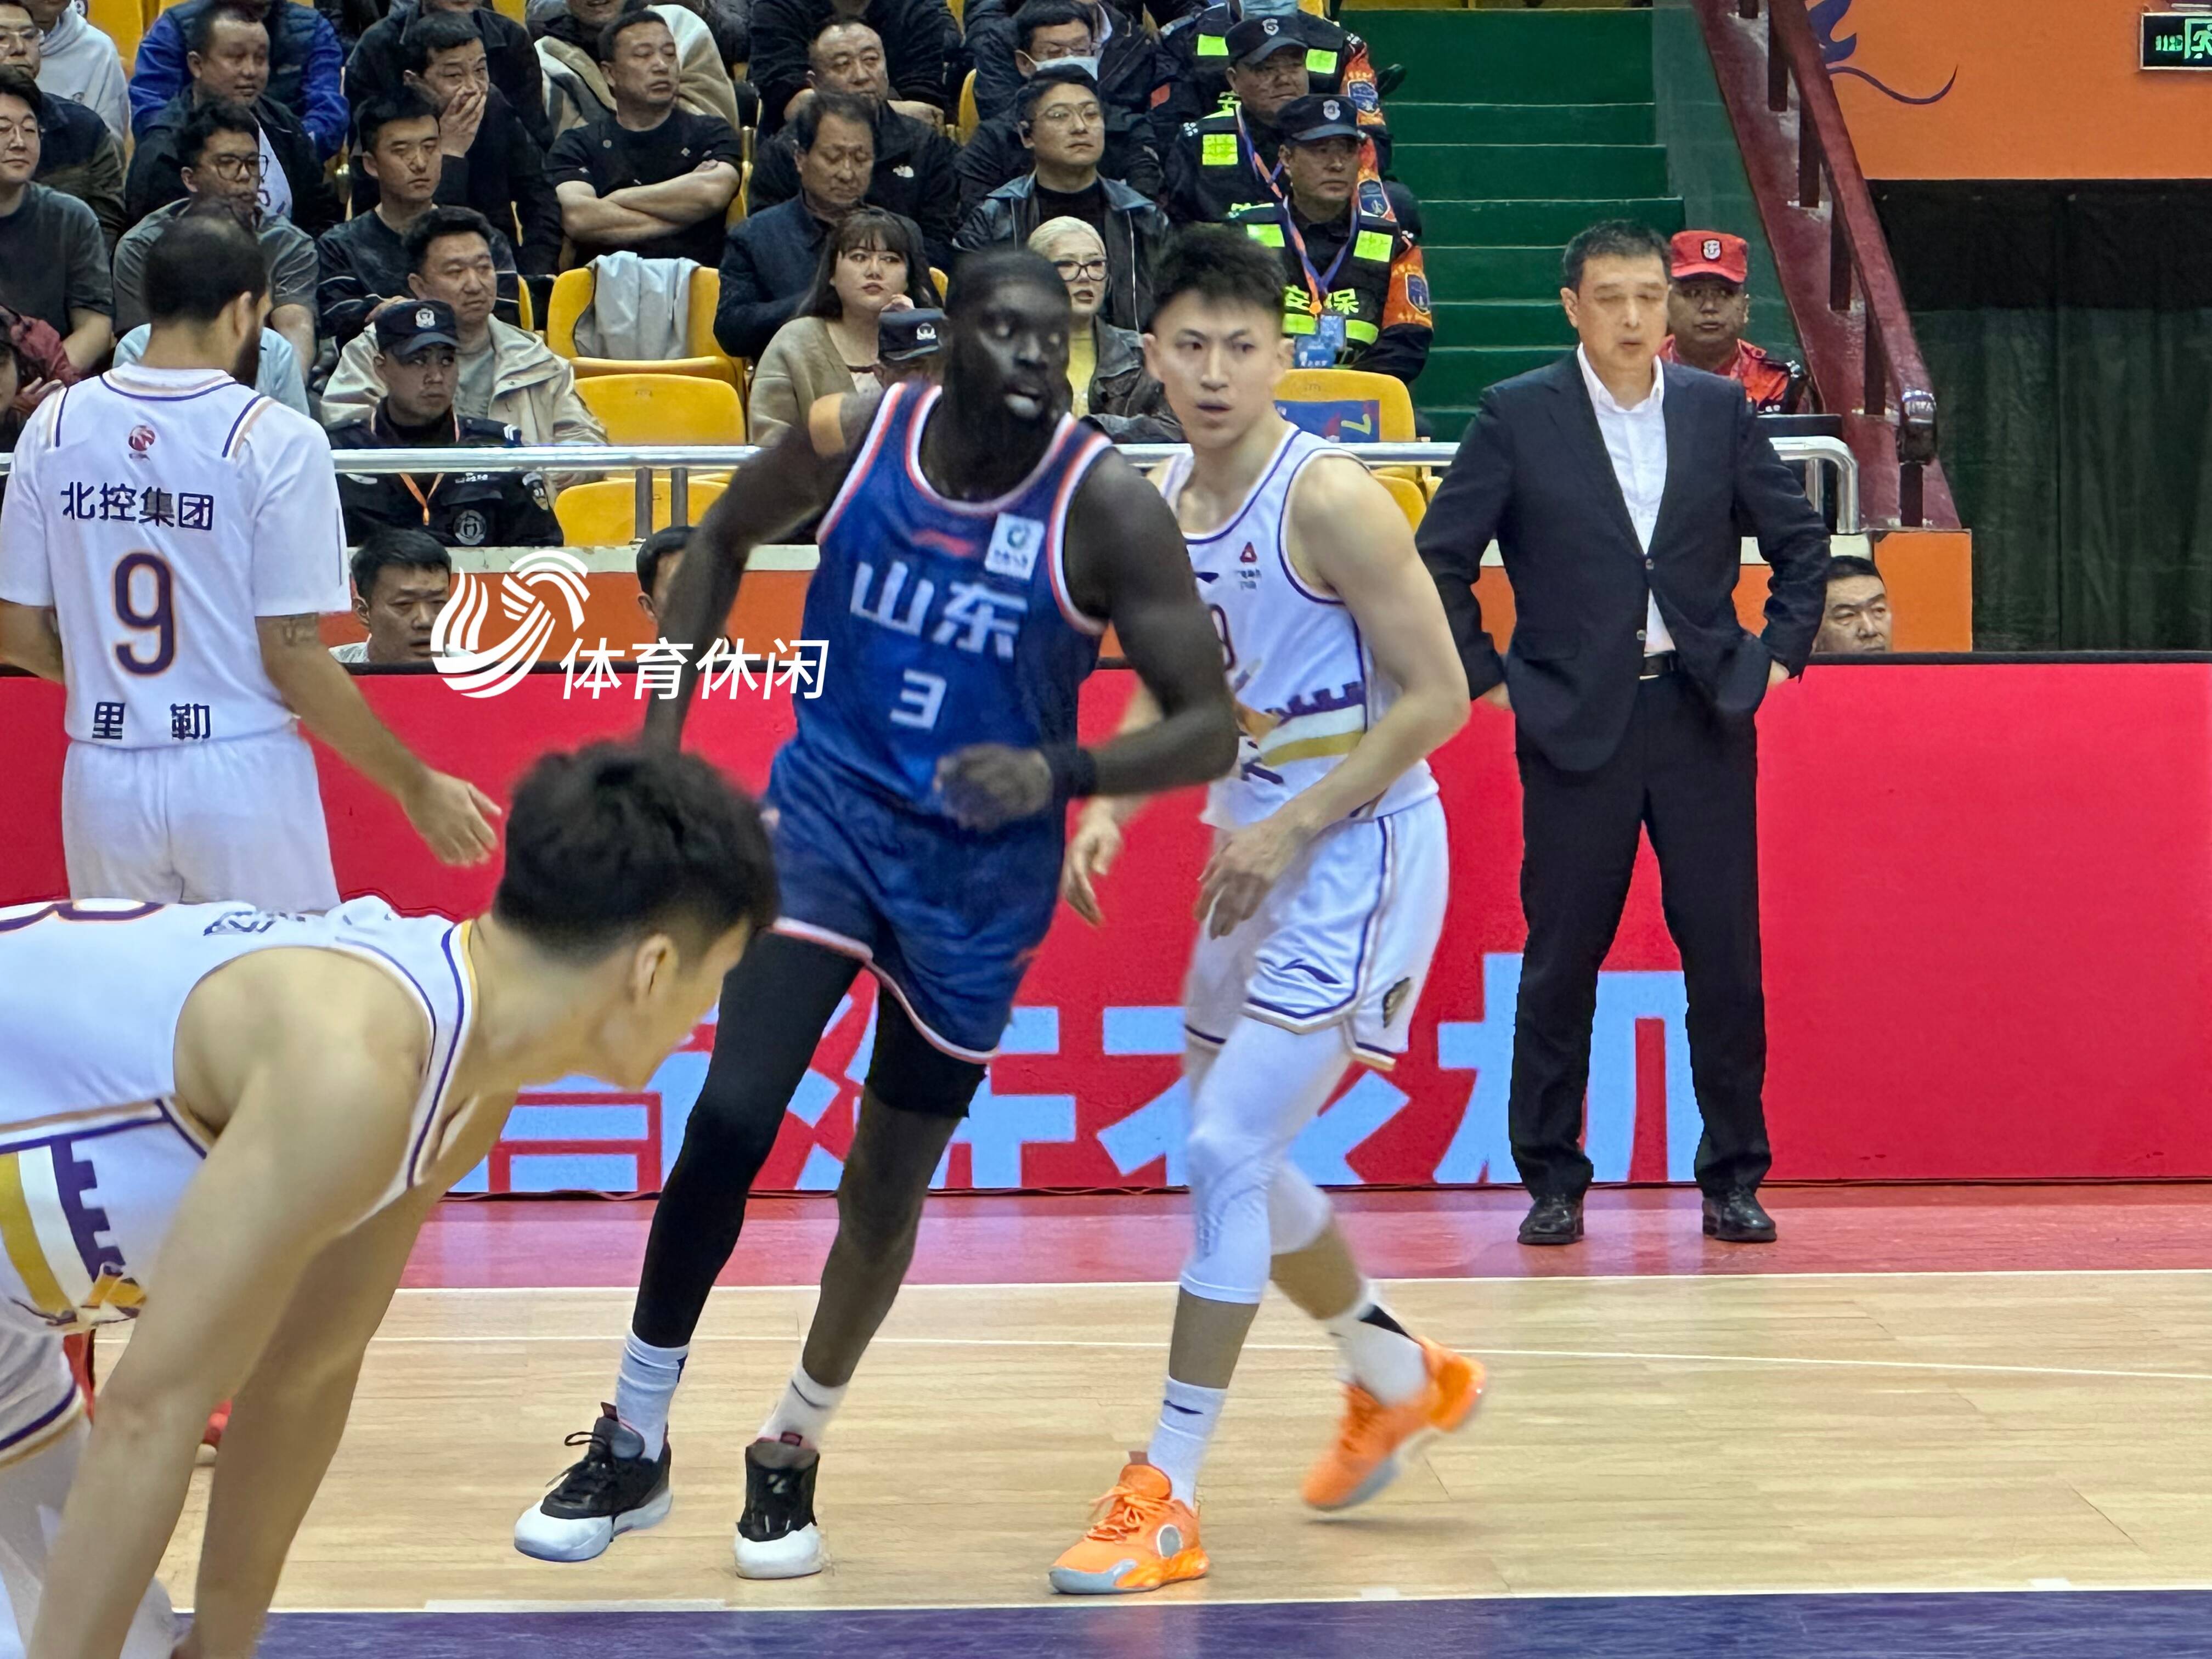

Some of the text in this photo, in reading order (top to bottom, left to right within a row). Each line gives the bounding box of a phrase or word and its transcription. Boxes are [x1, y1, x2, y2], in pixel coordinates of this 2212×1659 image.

[60, 482, 214, 531] 北控集团
[114, 552, 176, 676] 9
[850, 561, 1028, 659] 山东
[890, 668, 947, 731] 3
